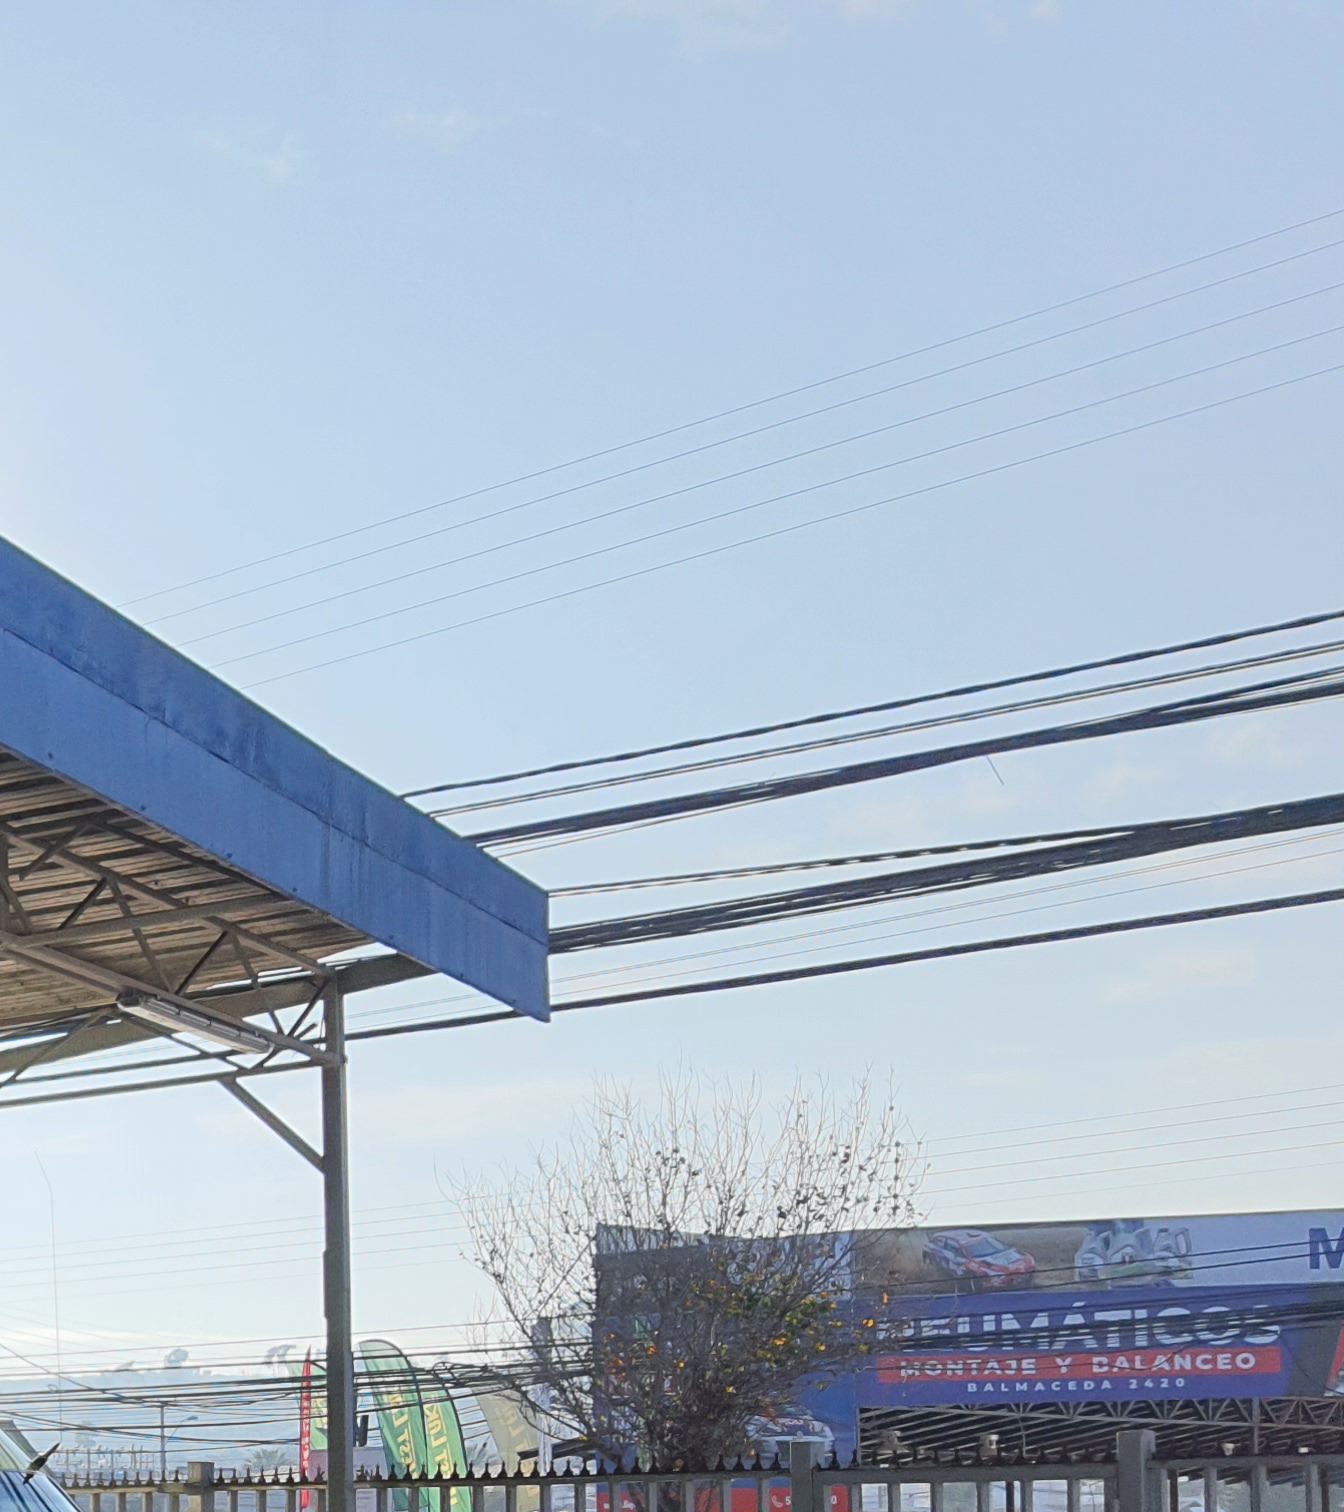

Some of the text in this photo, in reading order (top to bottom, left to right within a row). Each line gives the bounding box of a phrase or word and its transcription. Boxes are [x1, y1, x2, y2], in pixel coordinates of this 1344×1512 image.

[900, 1352, 1256, 1377] MONTAJE Y BALANCEO
[967, 1377, 1185, 1392] BALMACEDA 2420
